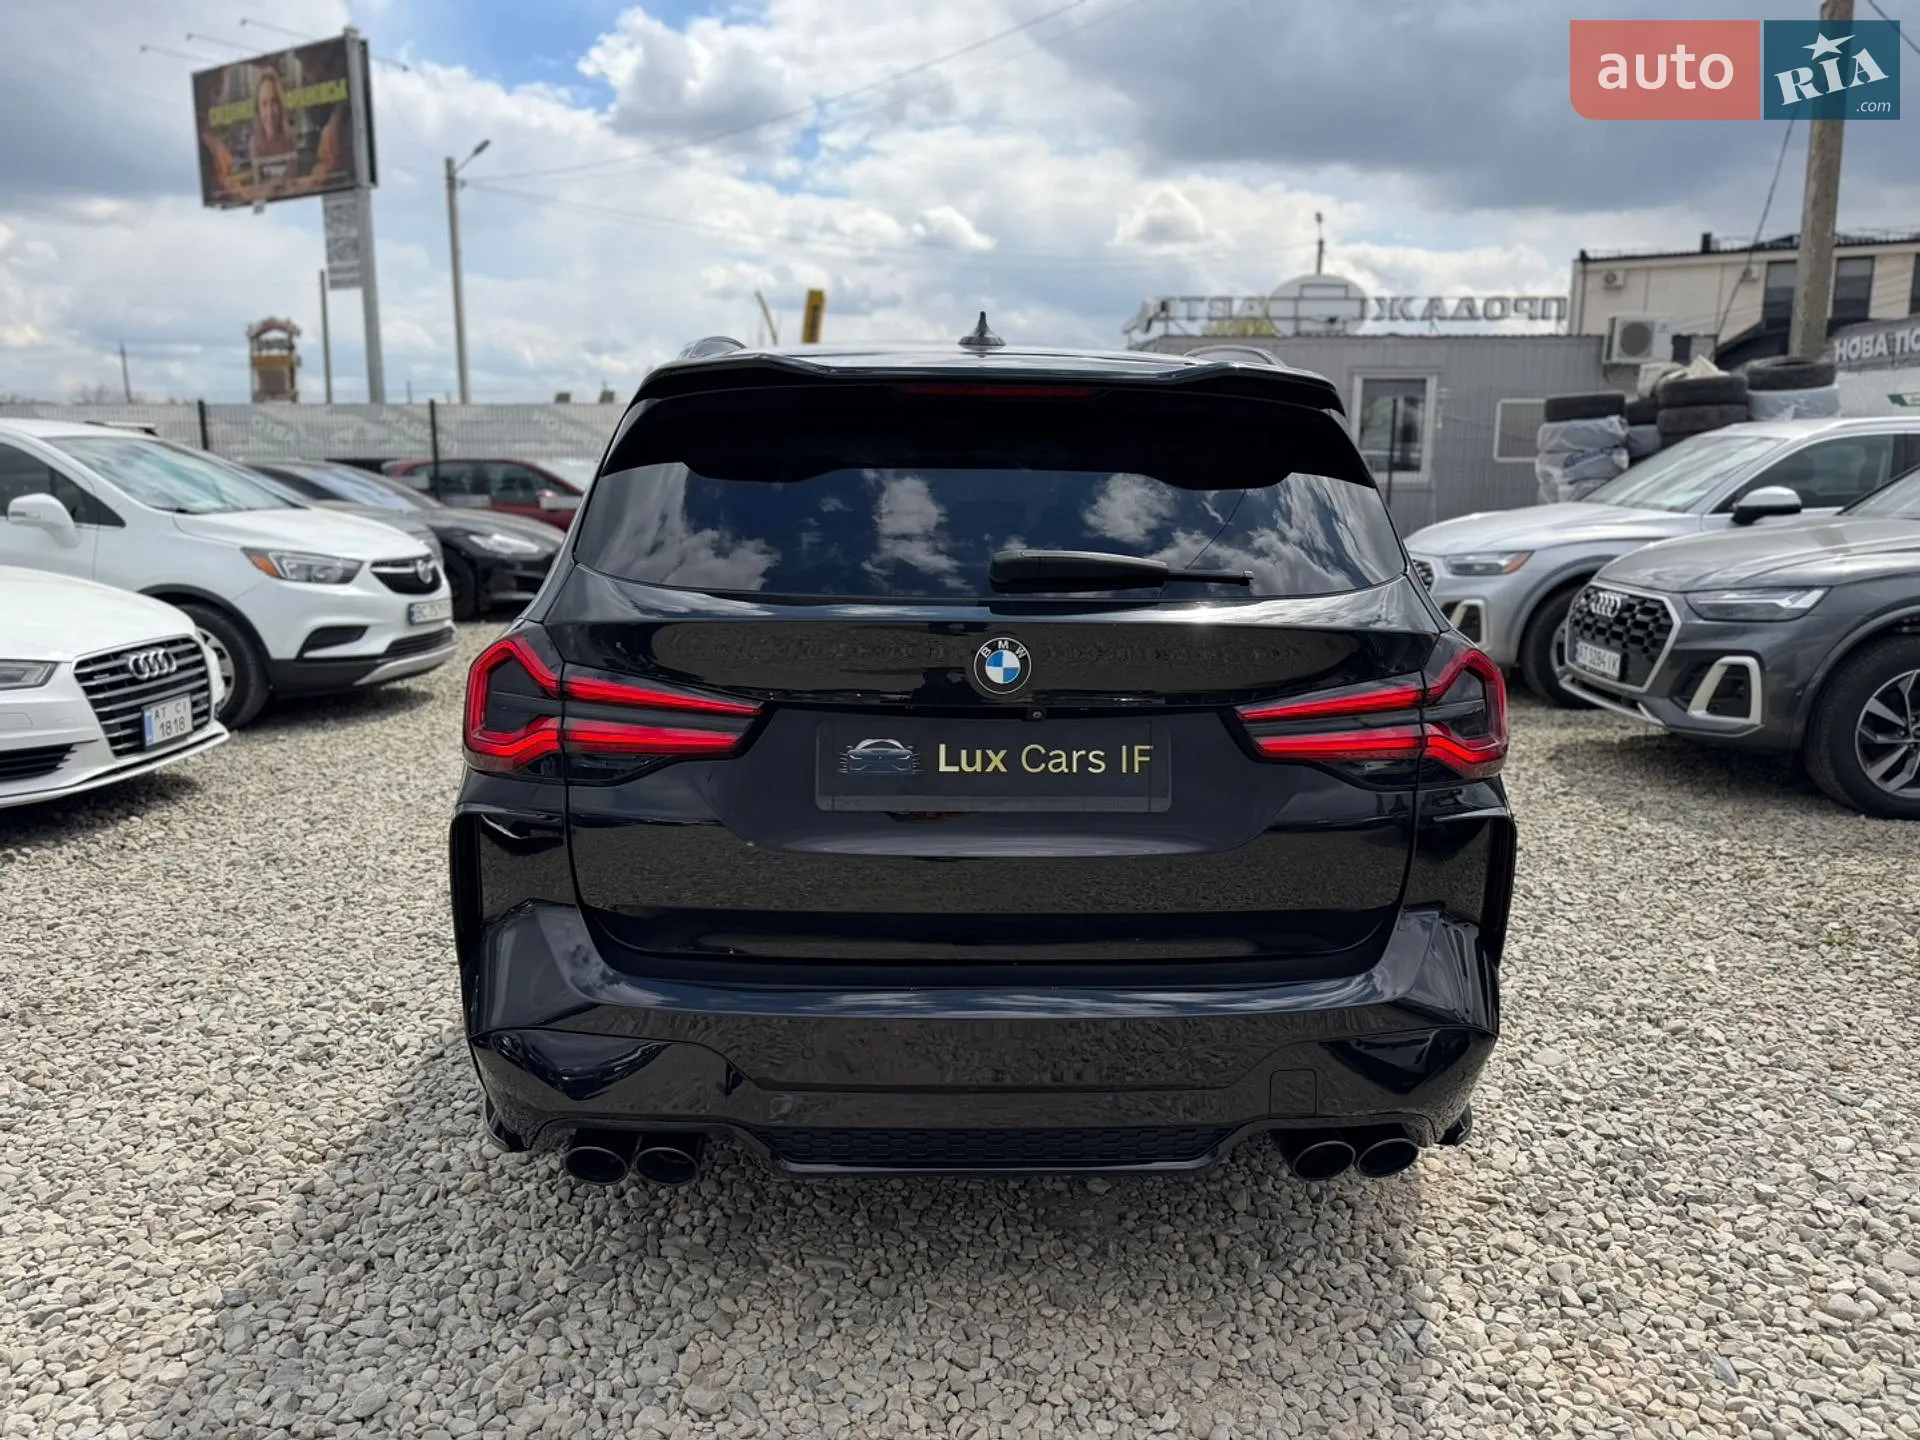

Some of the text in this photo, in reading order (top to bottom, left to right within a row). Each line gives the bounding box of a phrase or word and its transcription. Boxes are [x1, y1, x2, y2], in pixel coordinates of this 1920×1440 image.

[1833, 333, 1888, 362] НОВА
[980, 640, 1027, 658] BMW
[938, 743, 1154, 774] Lux Cars IF
